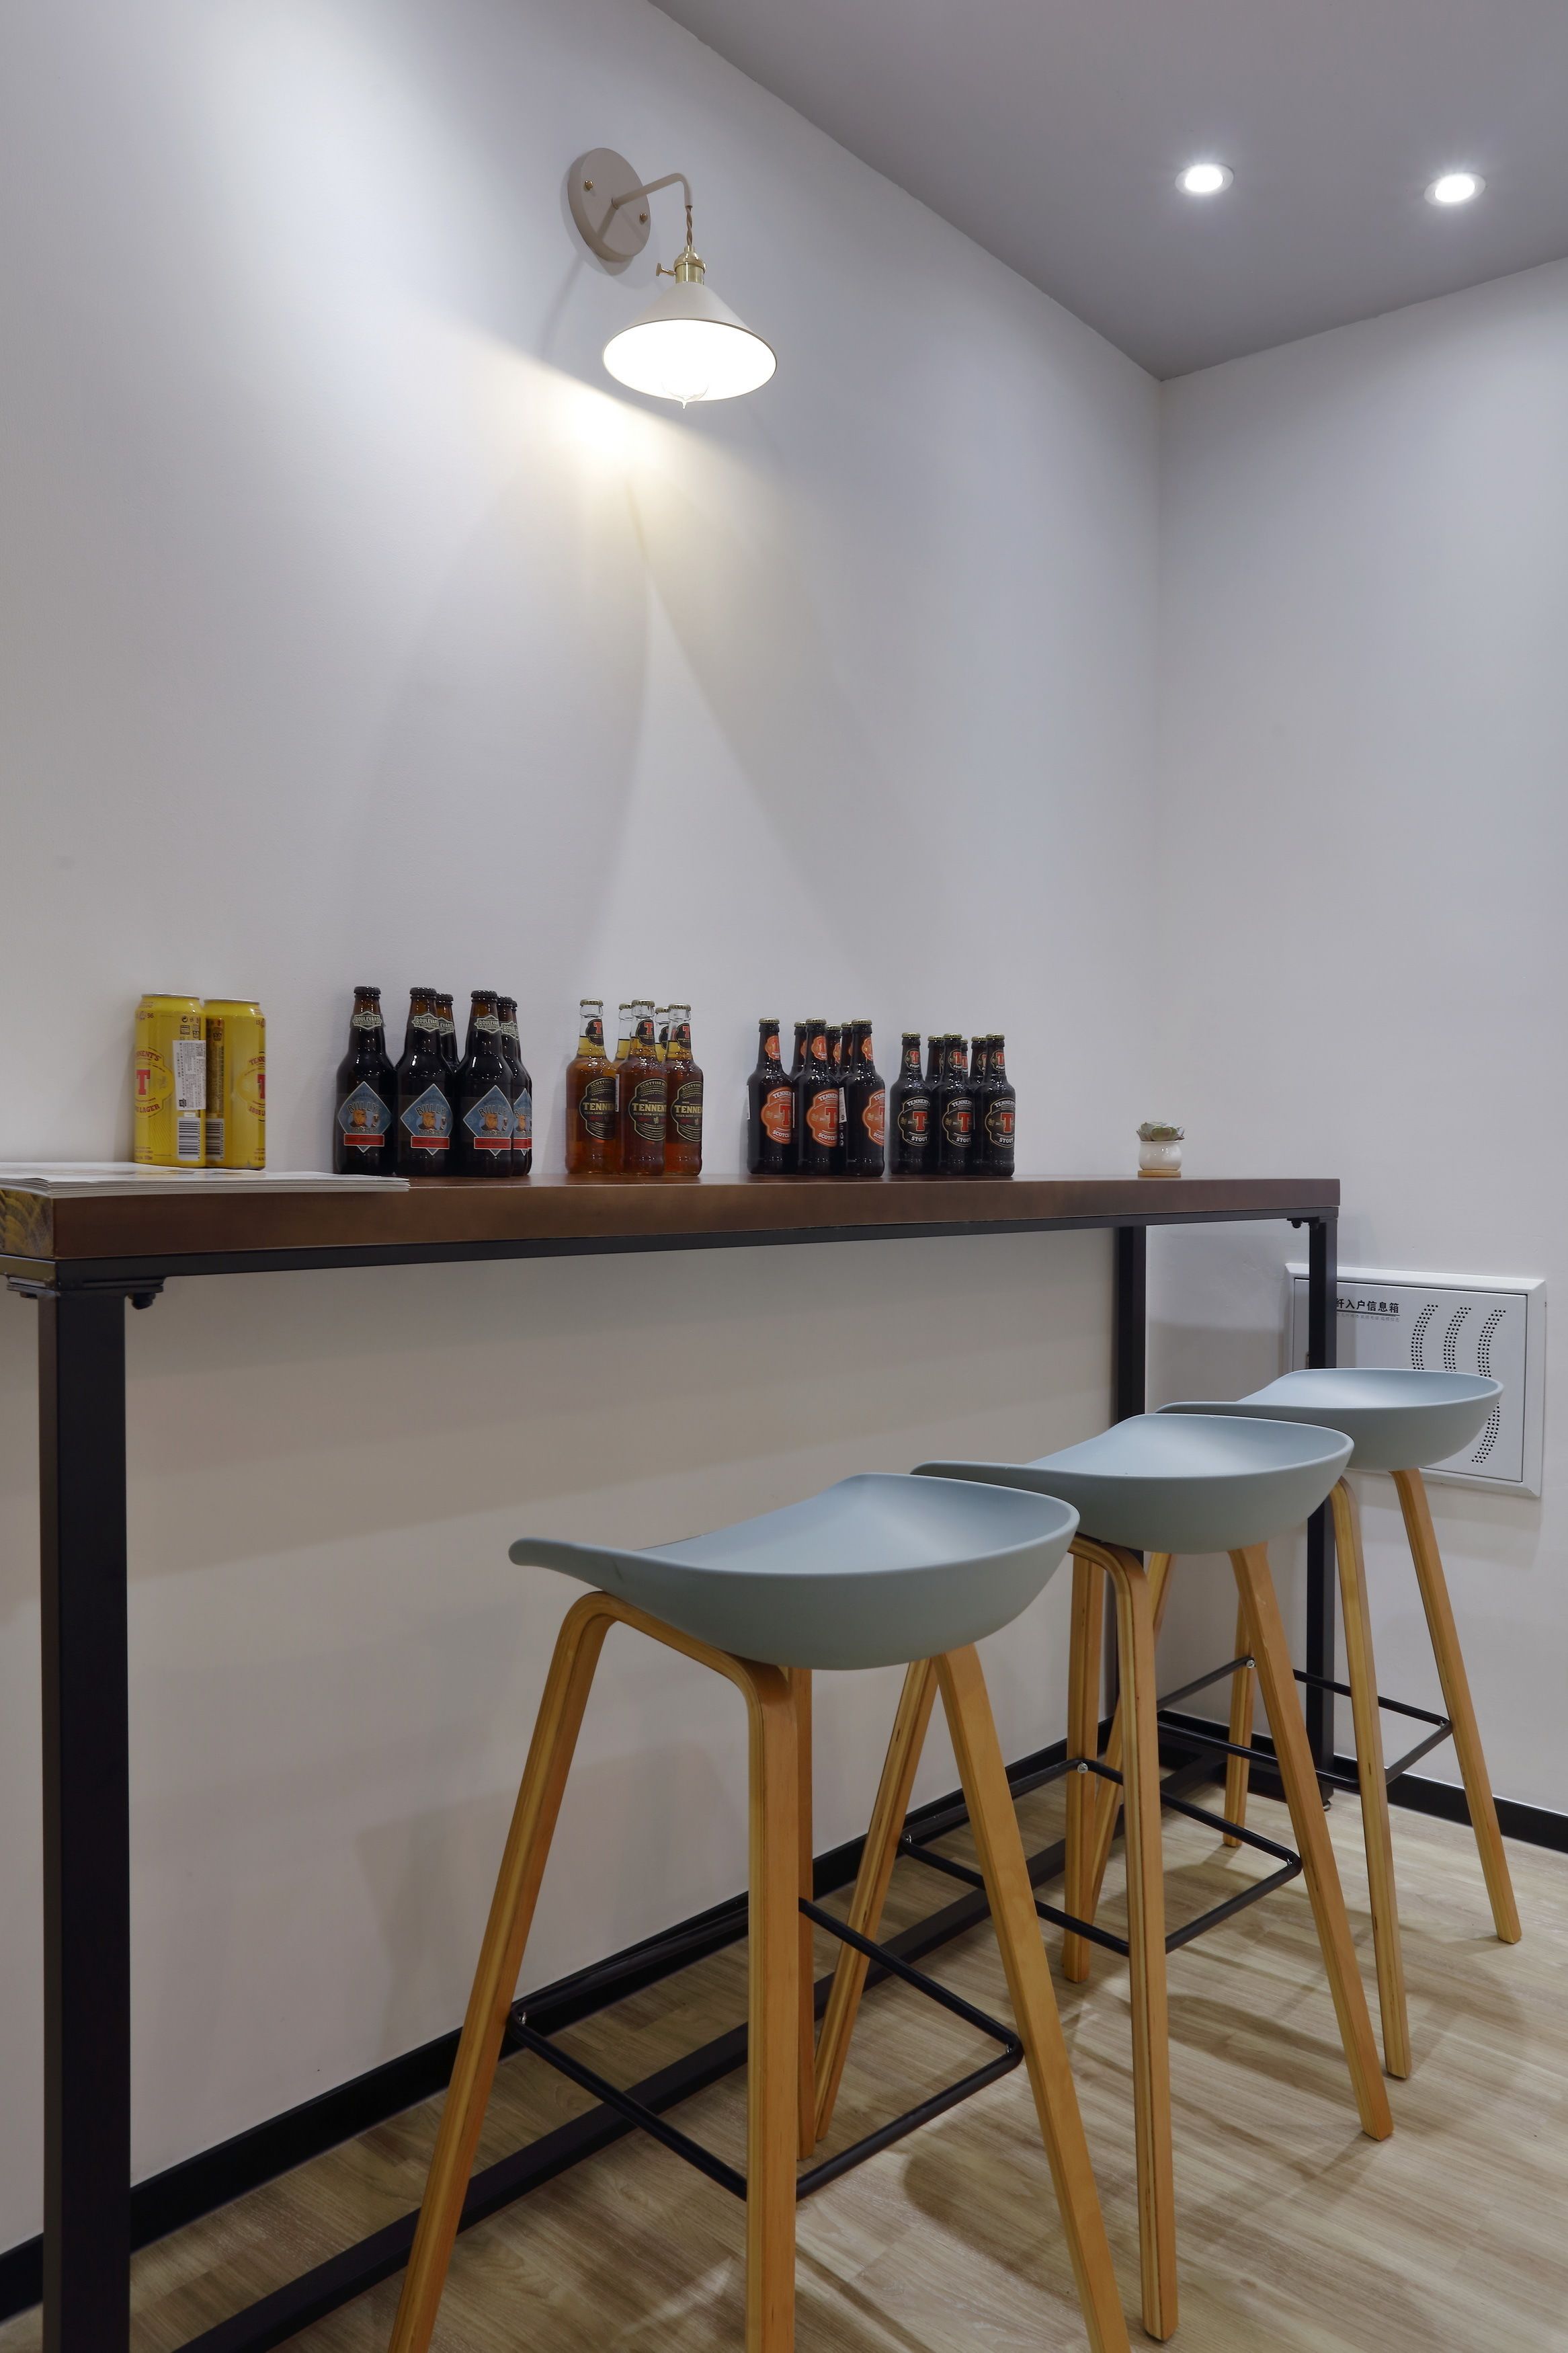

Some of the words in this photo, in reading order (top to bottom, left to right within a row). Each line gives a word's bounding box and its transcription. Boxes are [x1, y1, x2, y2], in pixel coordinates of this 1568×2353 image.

[355, 1016, 379, 1024] BOULEVARD
[416, 1018, 438, 1026] BOULEVA
[479, 1020, 499, 1028] BOULEVA
[644, 1022, 653, 1035] T
[909, 1050, 919, 1064] T
[136, 1070, 151, 1095] T
[140, 1103, 161, 1113] LAGER
[583, 1102, 613, 1111] TENNE
[632, 1103, 667, 1113] TENNENT
[951, 1099, 973, 1107] TENNENT
[674, 1105, 703, 1114] TENNE
[824, 1106, 837, 1129] T
[913, 1111, 927, 1131] T
[957, 1112, 971, 1133] T
[1000, 1112, 1014, 1133] T
